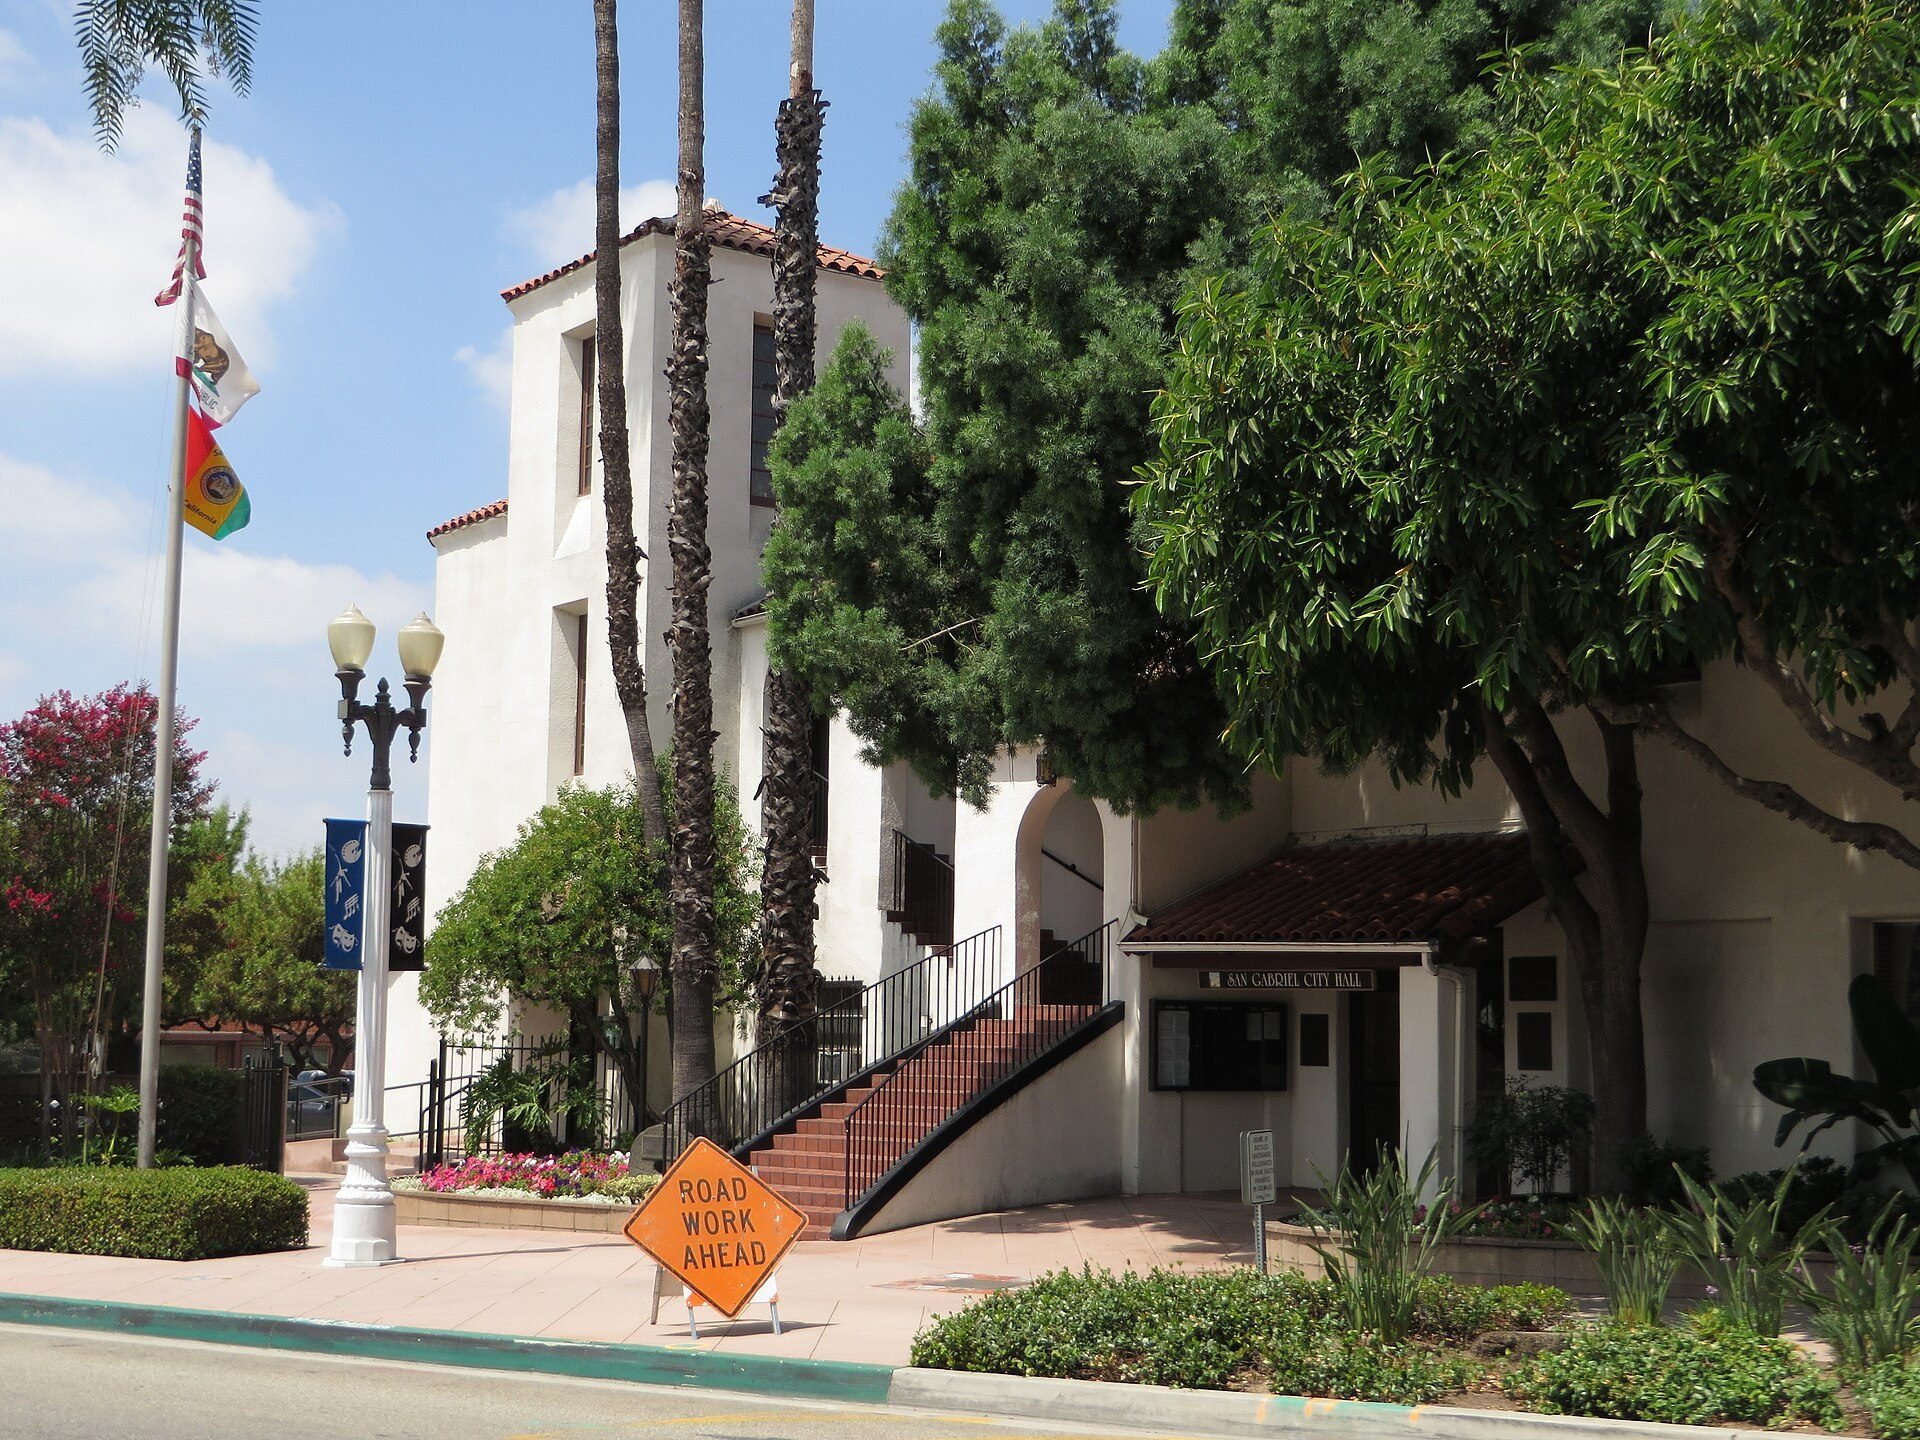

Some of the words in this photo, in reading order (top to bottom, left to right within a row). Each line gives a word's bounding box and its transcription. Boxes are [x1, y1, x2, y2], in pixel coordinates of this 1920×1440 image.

[184, 499, 217, 525] California
[1227, 972, 1247, 987] SAN
[1251, 972, 1299, 987] GABRIEL
[1303, 972, 1329, 987] CITY
[1334, 972, 1361, 987] HALL
[678, 1177, 747, 1204] ROAD
[681, 1208, 756, 1236] WORK
[683, 1240, 766, 1270] AHEAD
